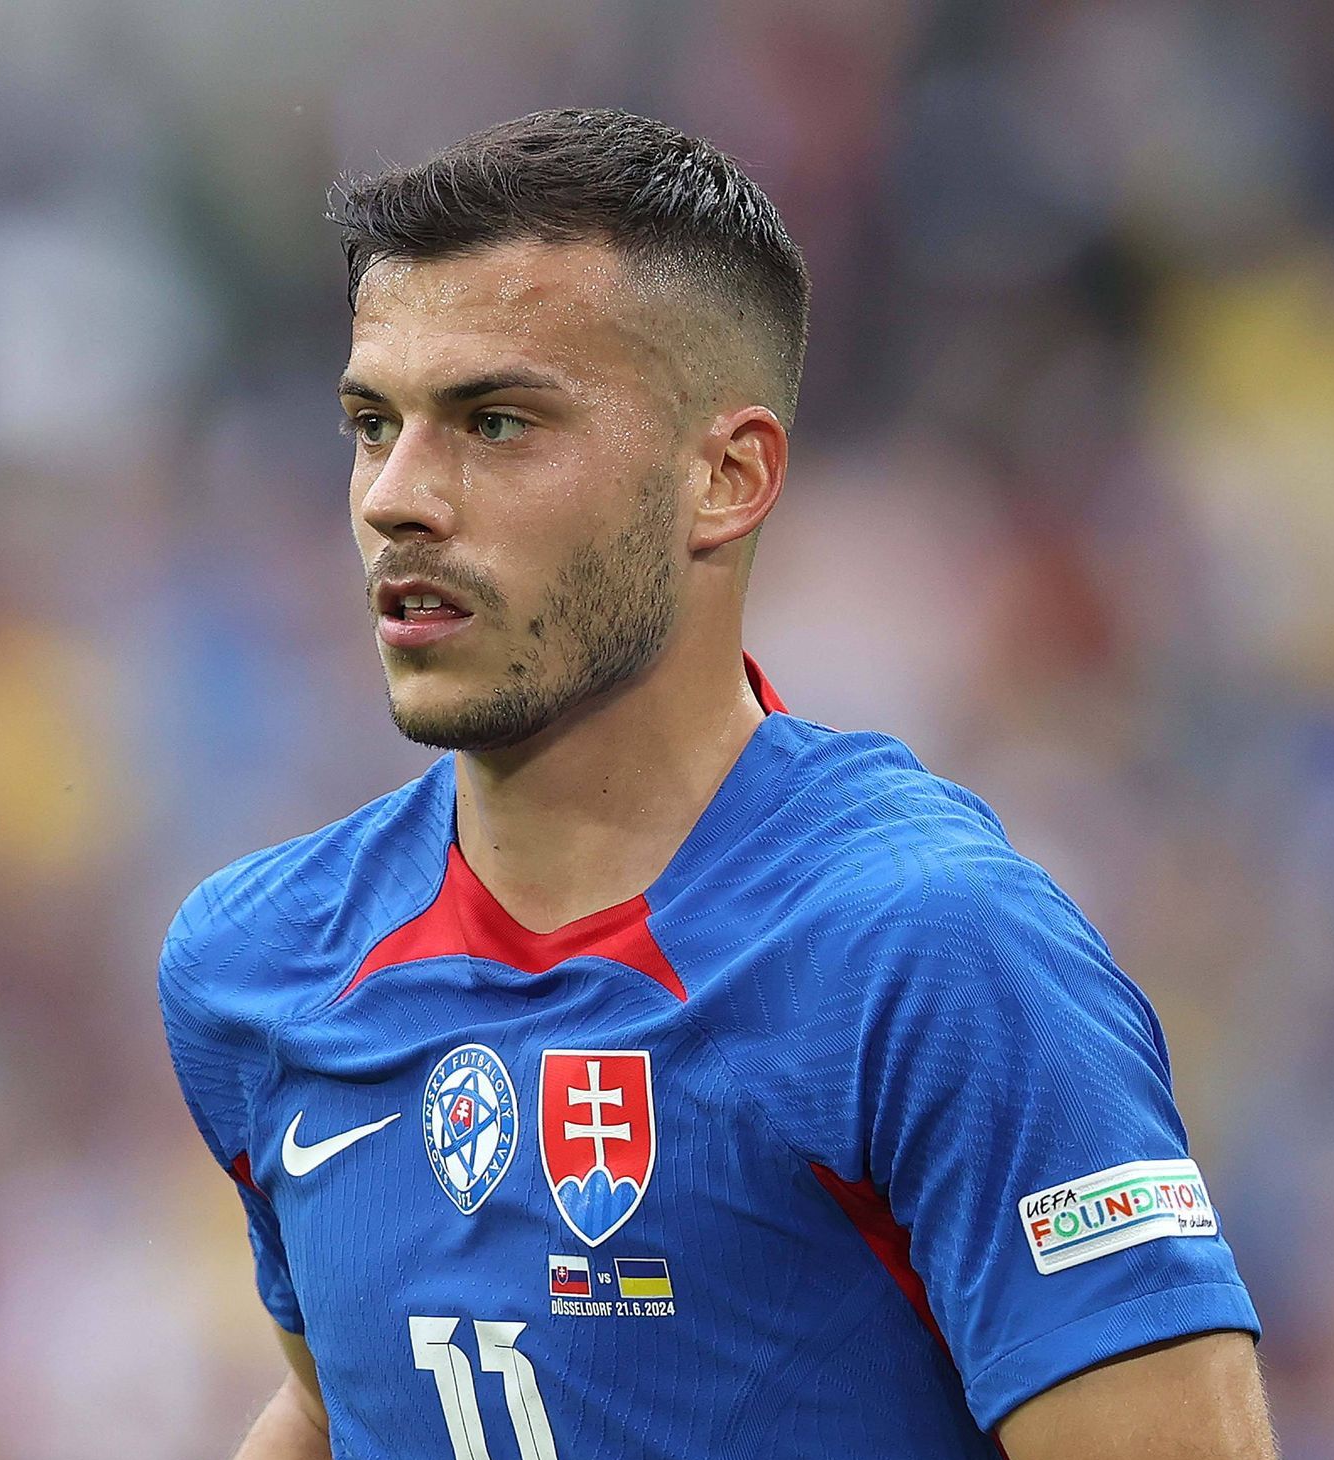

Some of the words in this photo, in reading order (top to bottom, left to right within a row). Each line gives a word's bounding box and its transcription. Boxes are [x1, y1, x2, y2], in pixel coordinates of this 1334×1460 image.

[452, 1052, 513, 1119] FUTBALOVÝ
[1026, 1189, 1077, 1218] UEFA
[551, 1298, 613, 1317] DÜSSELDORF
[616, 1301, 676, 1317] 21.6.2024
